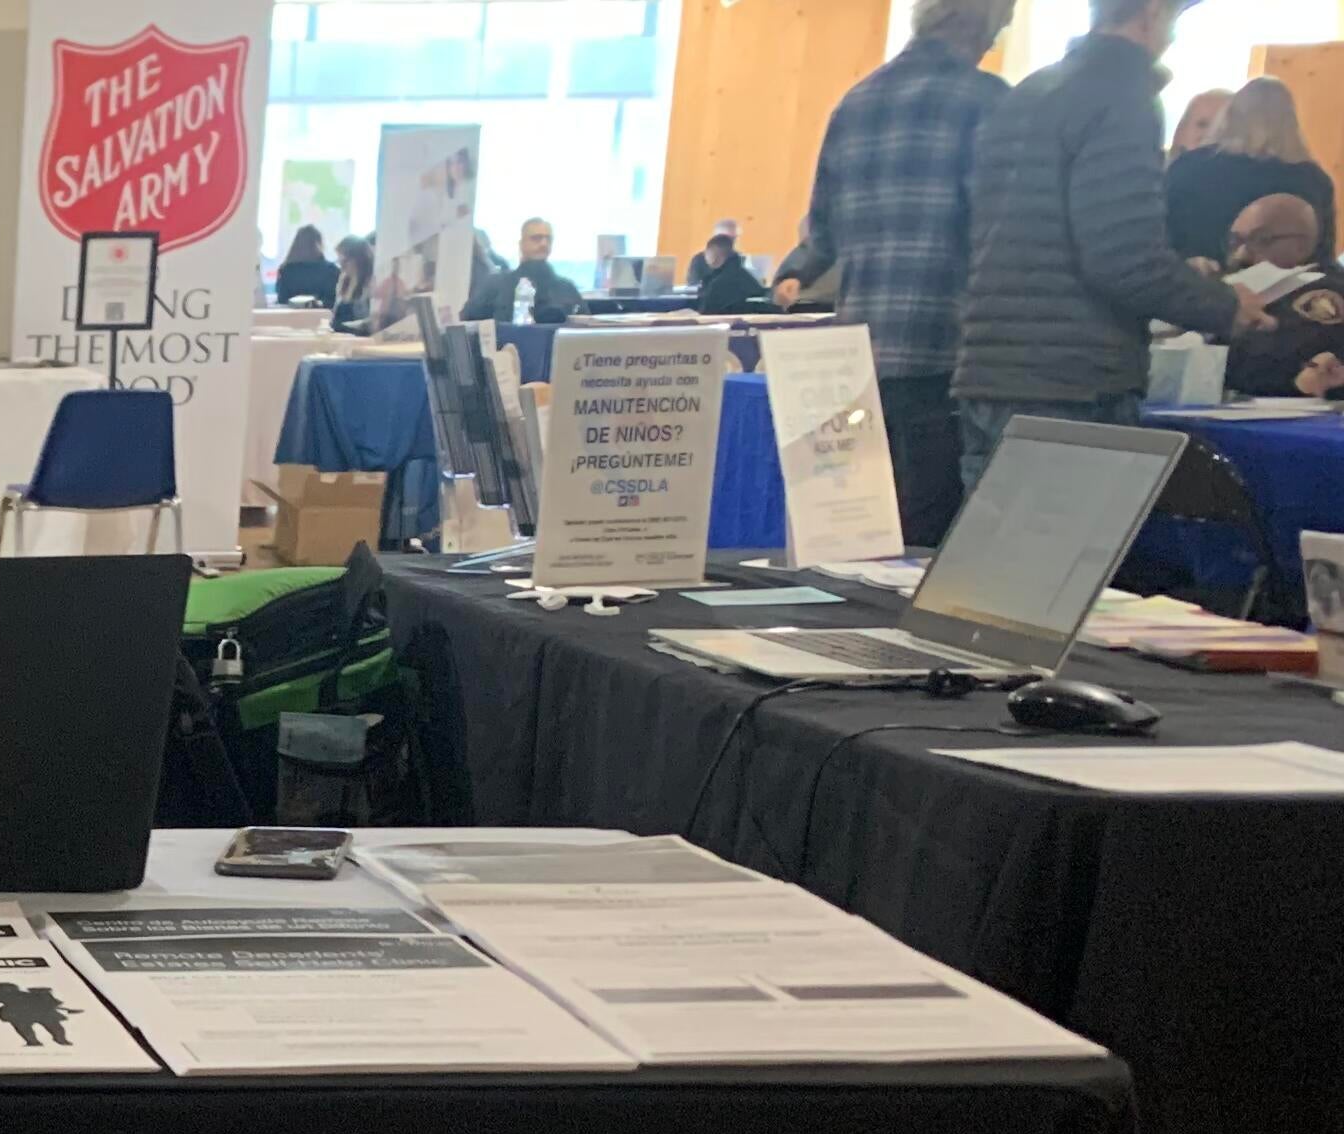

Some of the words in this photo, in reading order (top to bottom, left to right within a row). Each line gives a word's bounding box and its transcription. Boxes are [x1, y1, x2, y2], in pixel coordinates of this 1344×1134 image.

[84, 52, 163, 128] THE
[52, 62, 229, 208] SALVATION
[113, 130, 220, 232] ARMY
[61, 286, 211, 322] DNG
[26, 334, 105, 365] THE
[120, 332, 240, 365] MOST
[573, 354, 622, 371] ¿Tiene
[625, 352, 698, 370] preguntas
[702, 354, 711, 365] o
[580, 376, 633, 388] necesita
[635, 375, 673, 389] ayuda
[676, 375, 699, 386] con
[573, 392, 701, 416] MANUTENCIÓN
[585, 427, 611, 444] DE
[615, 421, 685, 443] NIÑOS?
[570, 451, 694, 473] ¡PREGÚNTEME!
[590, 479, 669, 495] @CSSDLA
[114, 951, 224, 960] Remote
